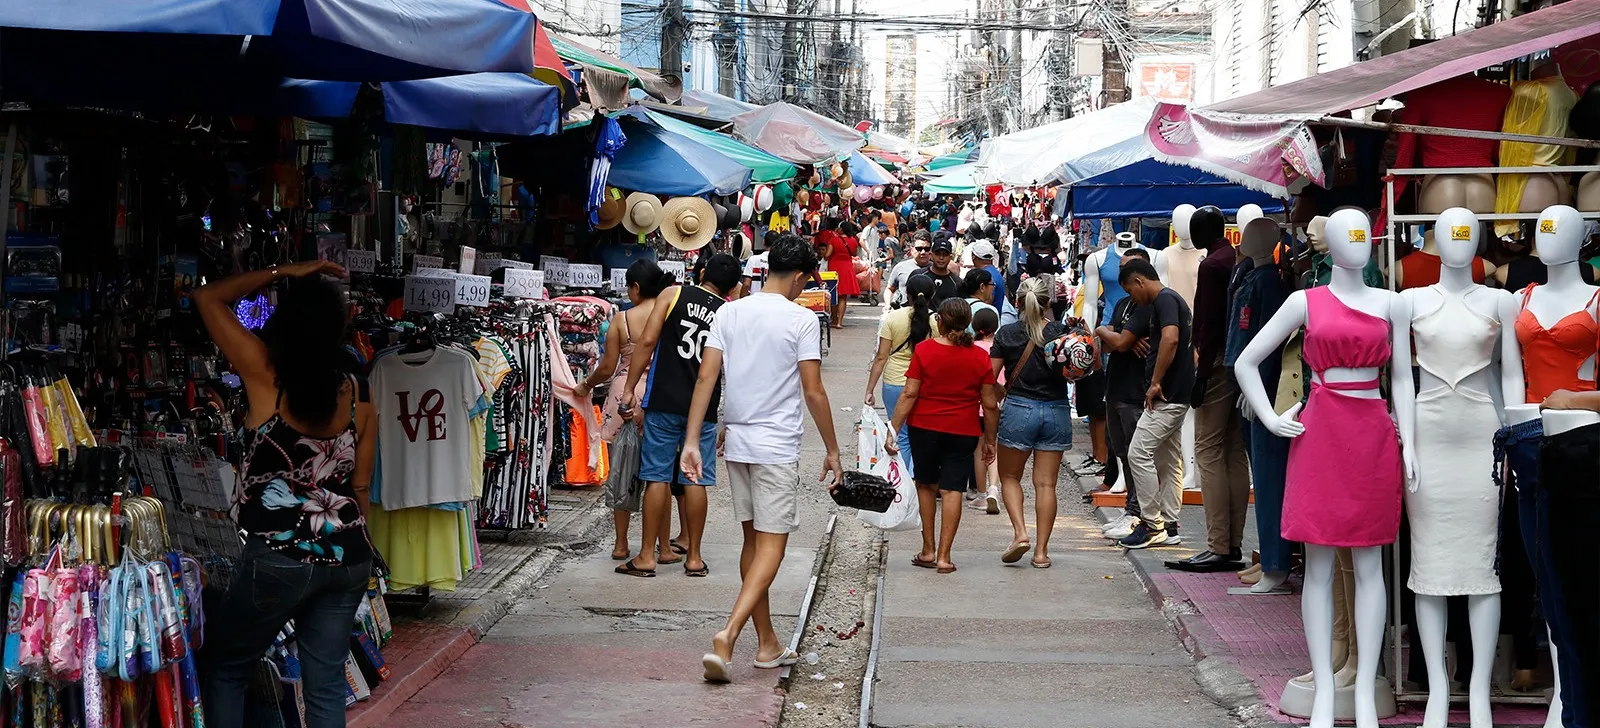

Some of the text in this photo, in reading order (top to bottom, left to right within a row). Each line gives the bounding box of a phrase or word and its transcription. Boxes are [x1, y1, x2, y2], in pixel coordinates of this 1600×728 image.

[409, 287, 450, 309] 14,99
[457, 285, 486, 304] 4,99
[687, 302, 714, 325] CURR
